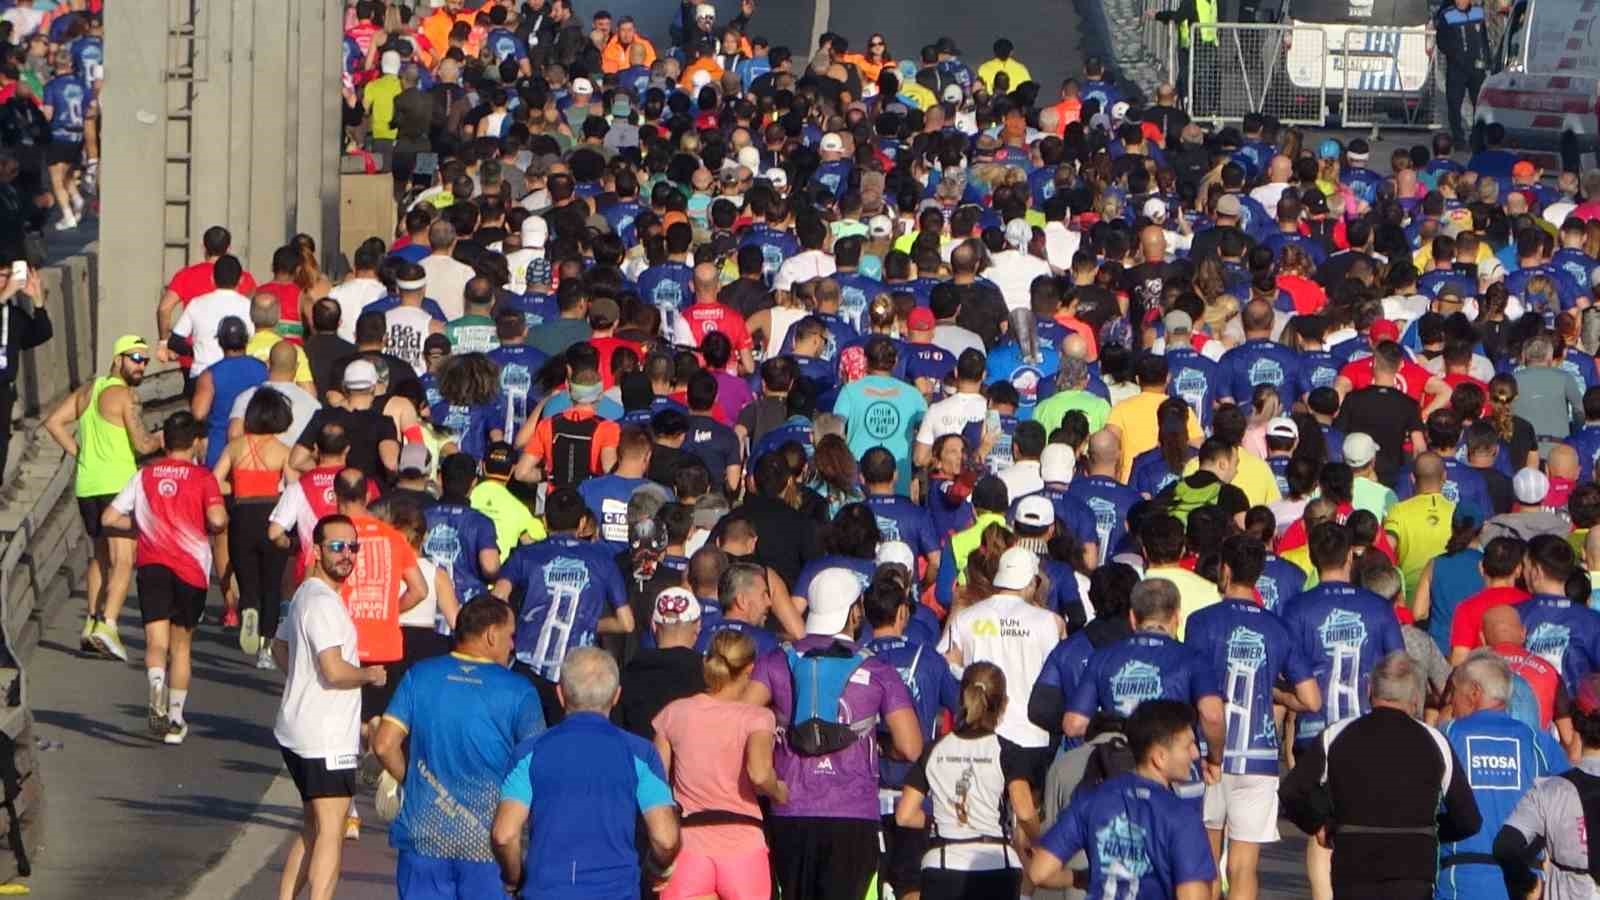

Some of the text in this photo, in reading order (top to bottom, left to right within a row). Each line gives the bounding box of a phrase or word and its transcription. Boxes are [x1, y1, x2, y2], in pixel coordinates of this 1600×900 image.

[999, 619, 1020, 628] RUN
[1000, 629, 1031, 638] URBAN
[1325, 628, 1364, 643] RUNNER
[1115, 681, 1159, 697] RUNNER
[1471, 756, 1517, 770] STOSA
